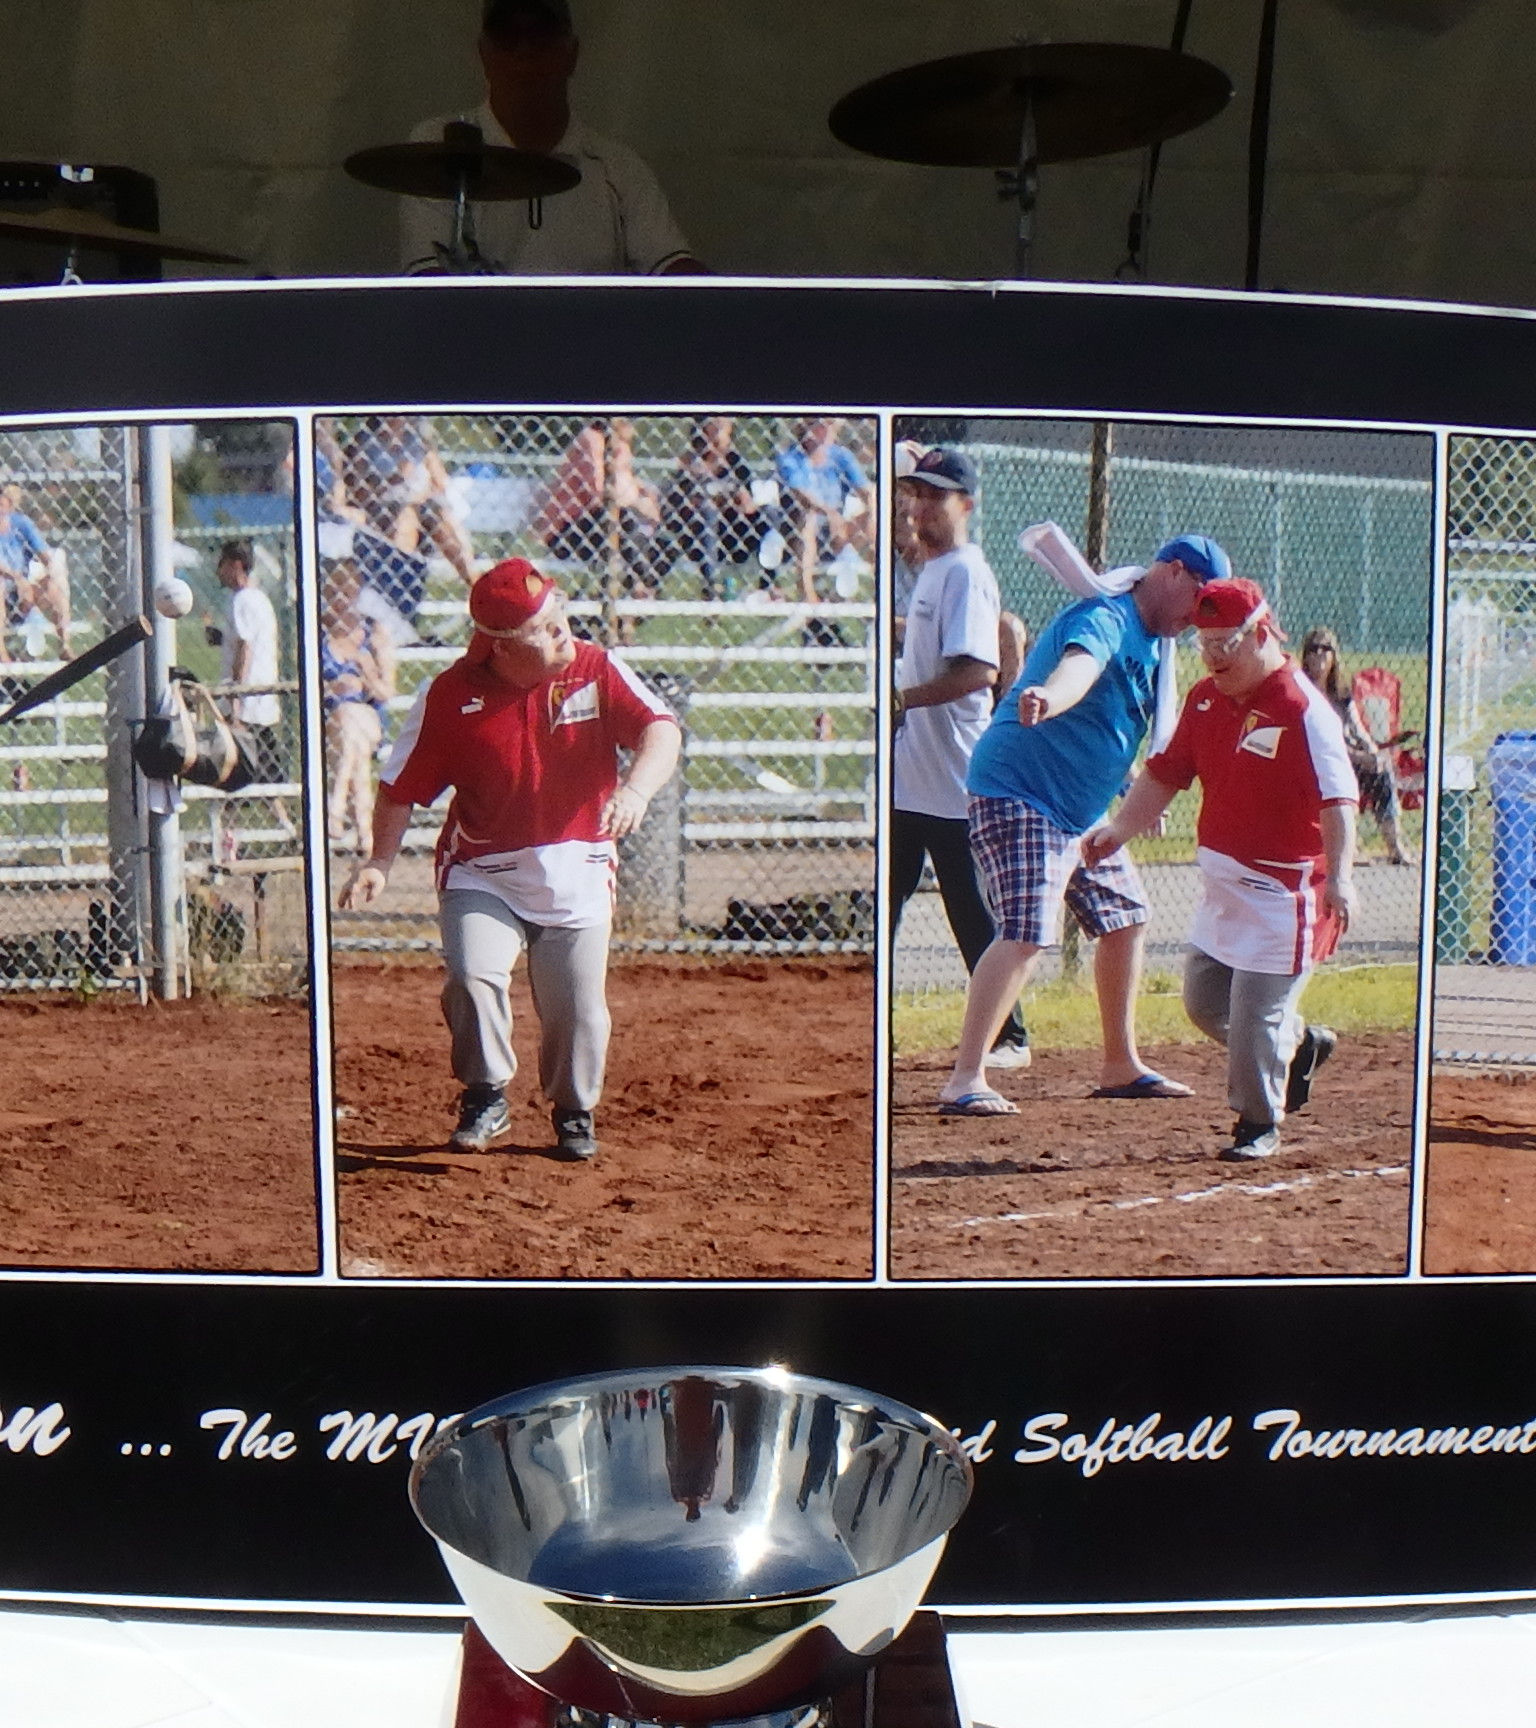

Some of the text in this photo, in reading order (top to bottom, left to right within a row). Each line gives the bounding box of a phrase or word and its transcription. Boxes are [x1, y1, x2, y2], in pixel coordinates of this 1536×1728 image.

[199, 1408, 297, 1461] The
[319, 1410, 465, 1464] MV
[1014, 1411, 1233, 1478] Softball
